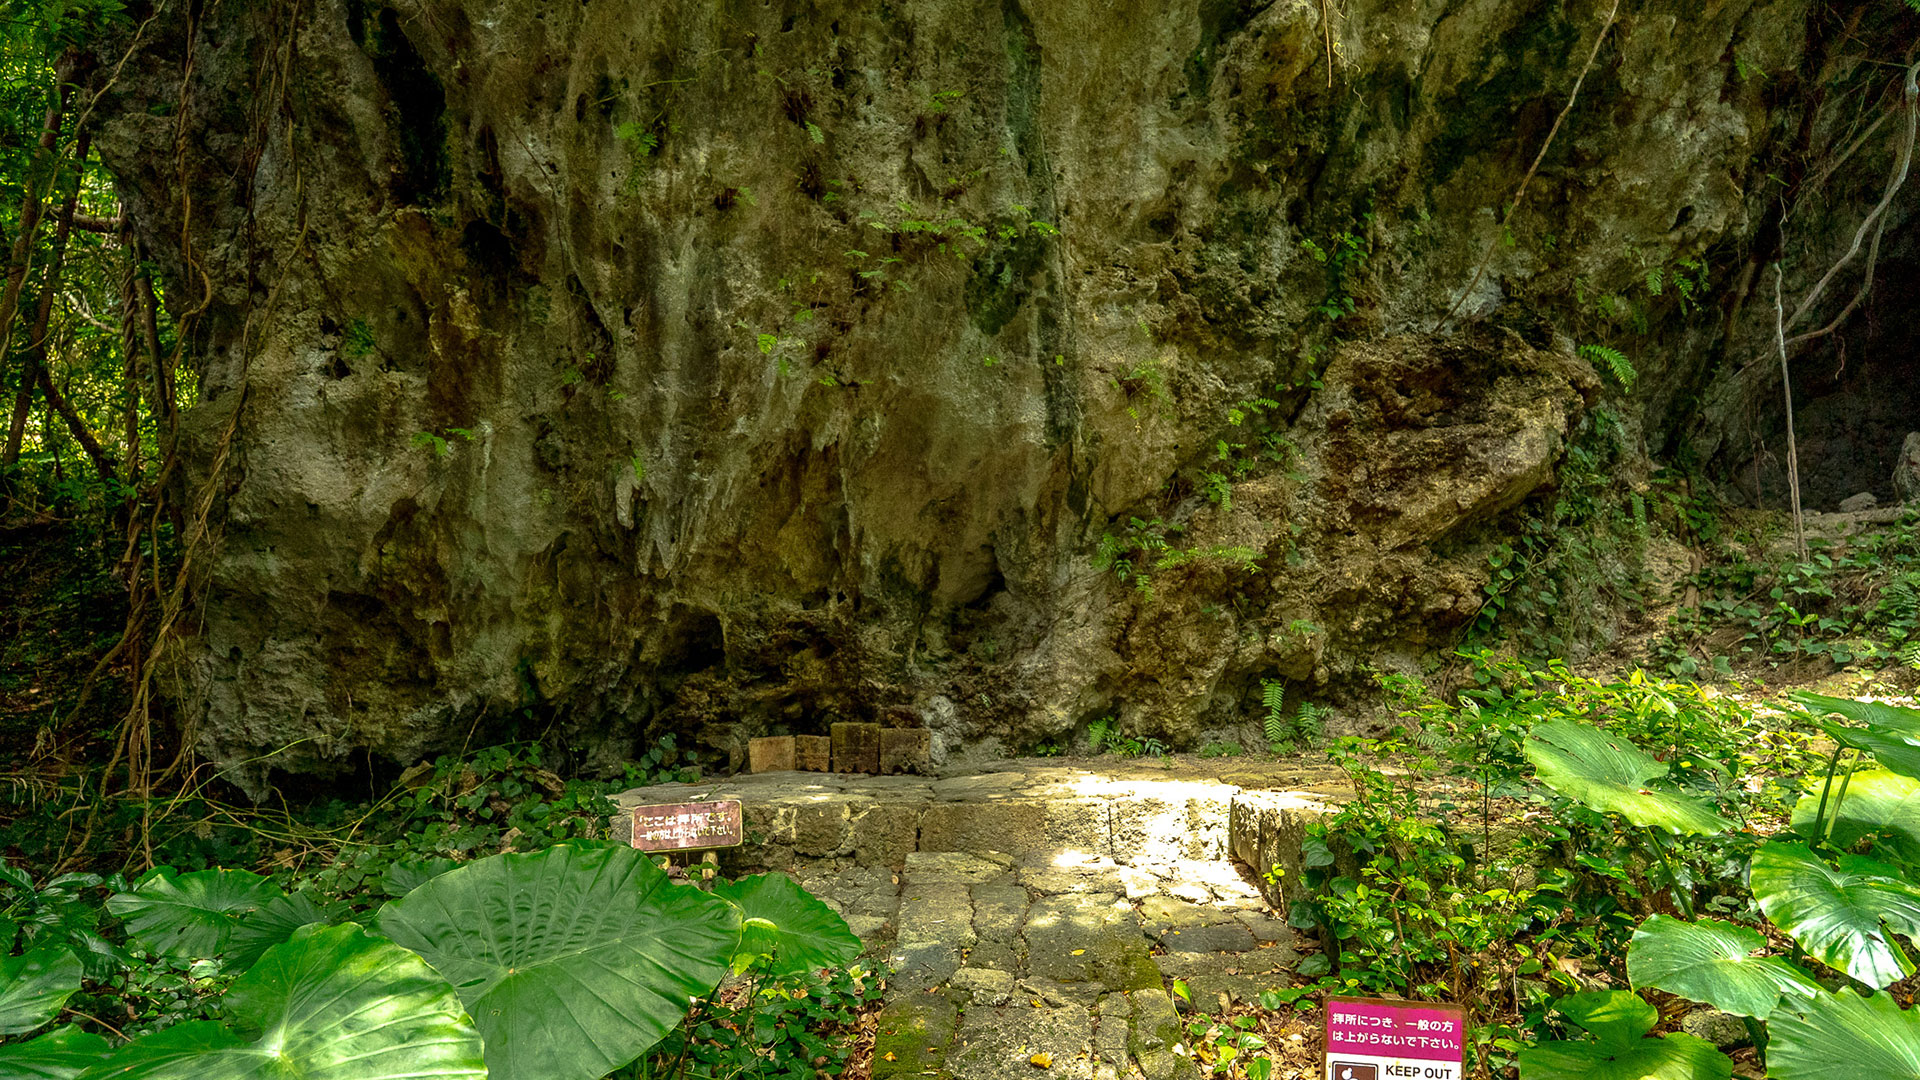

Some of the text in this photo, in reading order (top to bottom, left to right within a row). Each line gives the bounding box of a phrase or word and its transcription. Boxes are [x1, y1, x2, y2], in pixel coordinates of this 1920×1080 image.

[1332, 1012, 1454, 1033] 拝所につき、一般の方
[1332, 1030, 1460, 1050] は上がらないで下さい。
[1385, 1064, 1452, 1080] KEEP OUT
